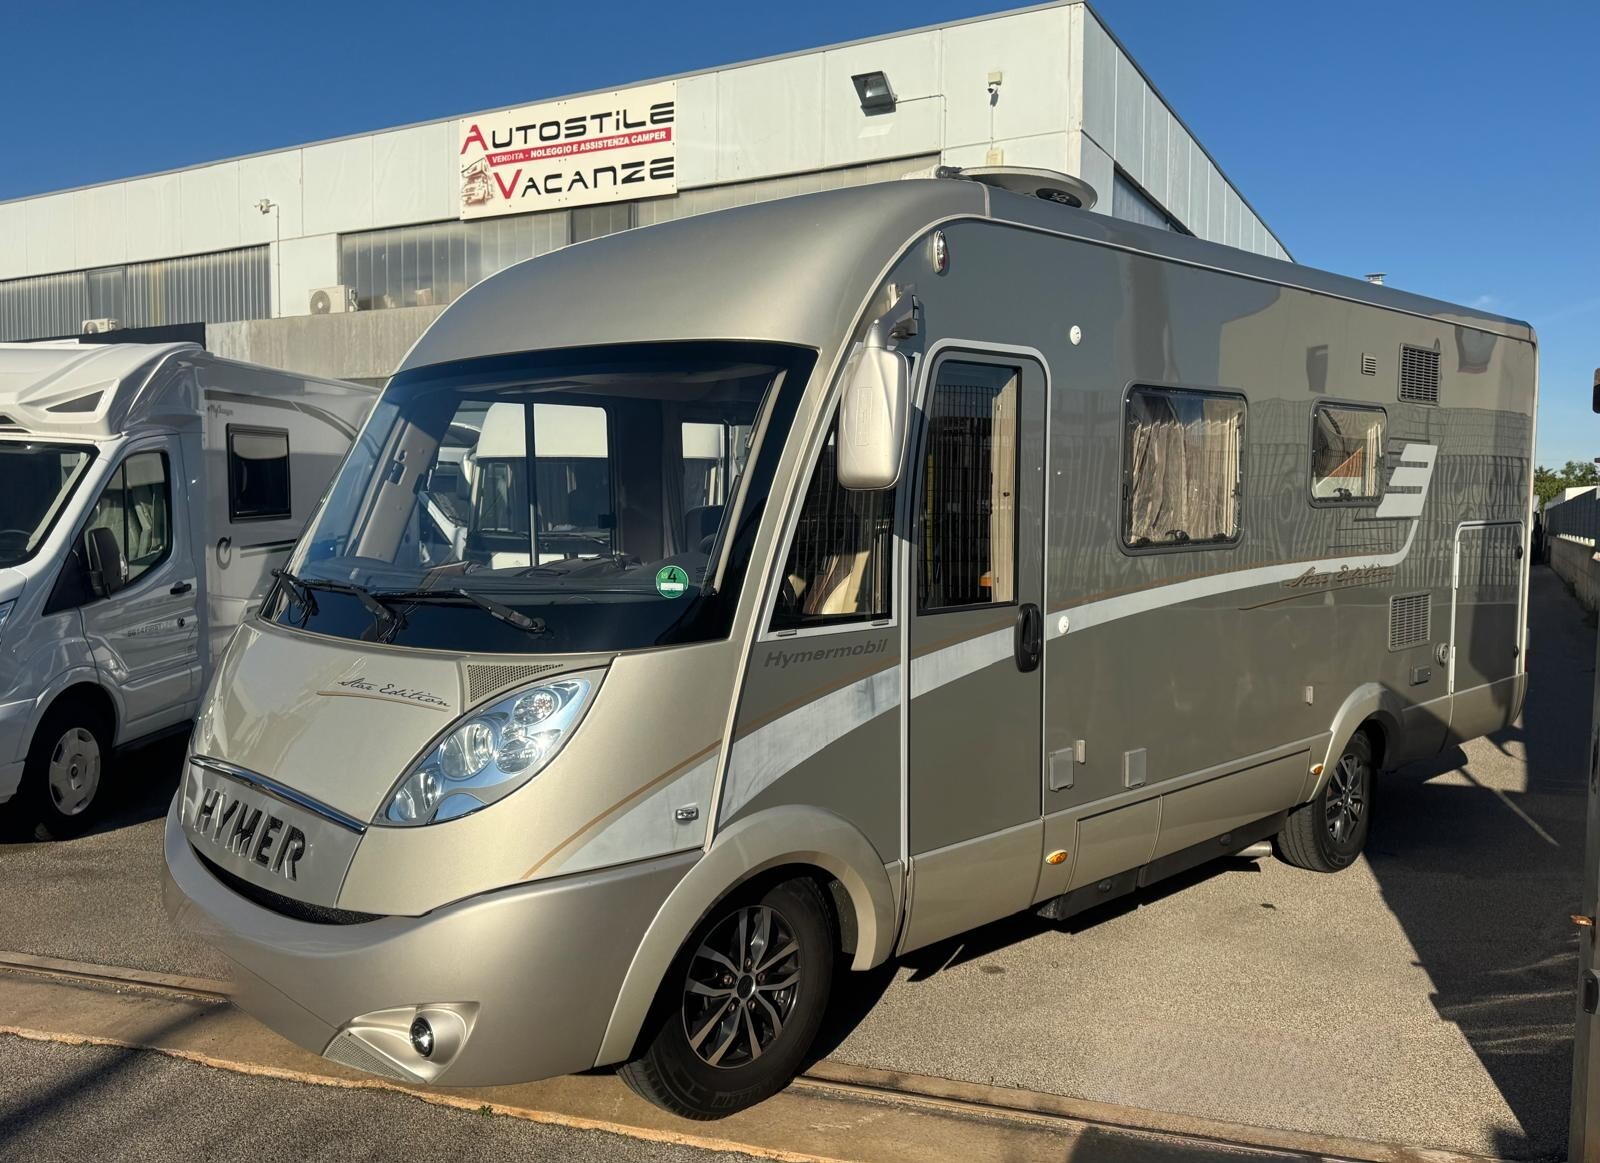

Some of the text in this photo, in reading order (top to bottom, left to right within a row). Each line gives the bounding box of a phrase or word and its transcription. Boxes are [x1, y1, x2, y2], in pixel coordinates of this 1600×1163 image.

[492, 153, 524, 164] VENDITA
[530, 145, 572, 158] NOLEGGIO
[573, 143, 579, 153] E
[579, 136, 630, 151] ASSISTENZA
[631, 131, 667, 144] CAMPER
[667, 568, 677, 583] 4
[764, 638, 888, 669] Hymermobil
[337, 677, 451, 707] Star Edition
[193, 786, 306, 882] HYMER
